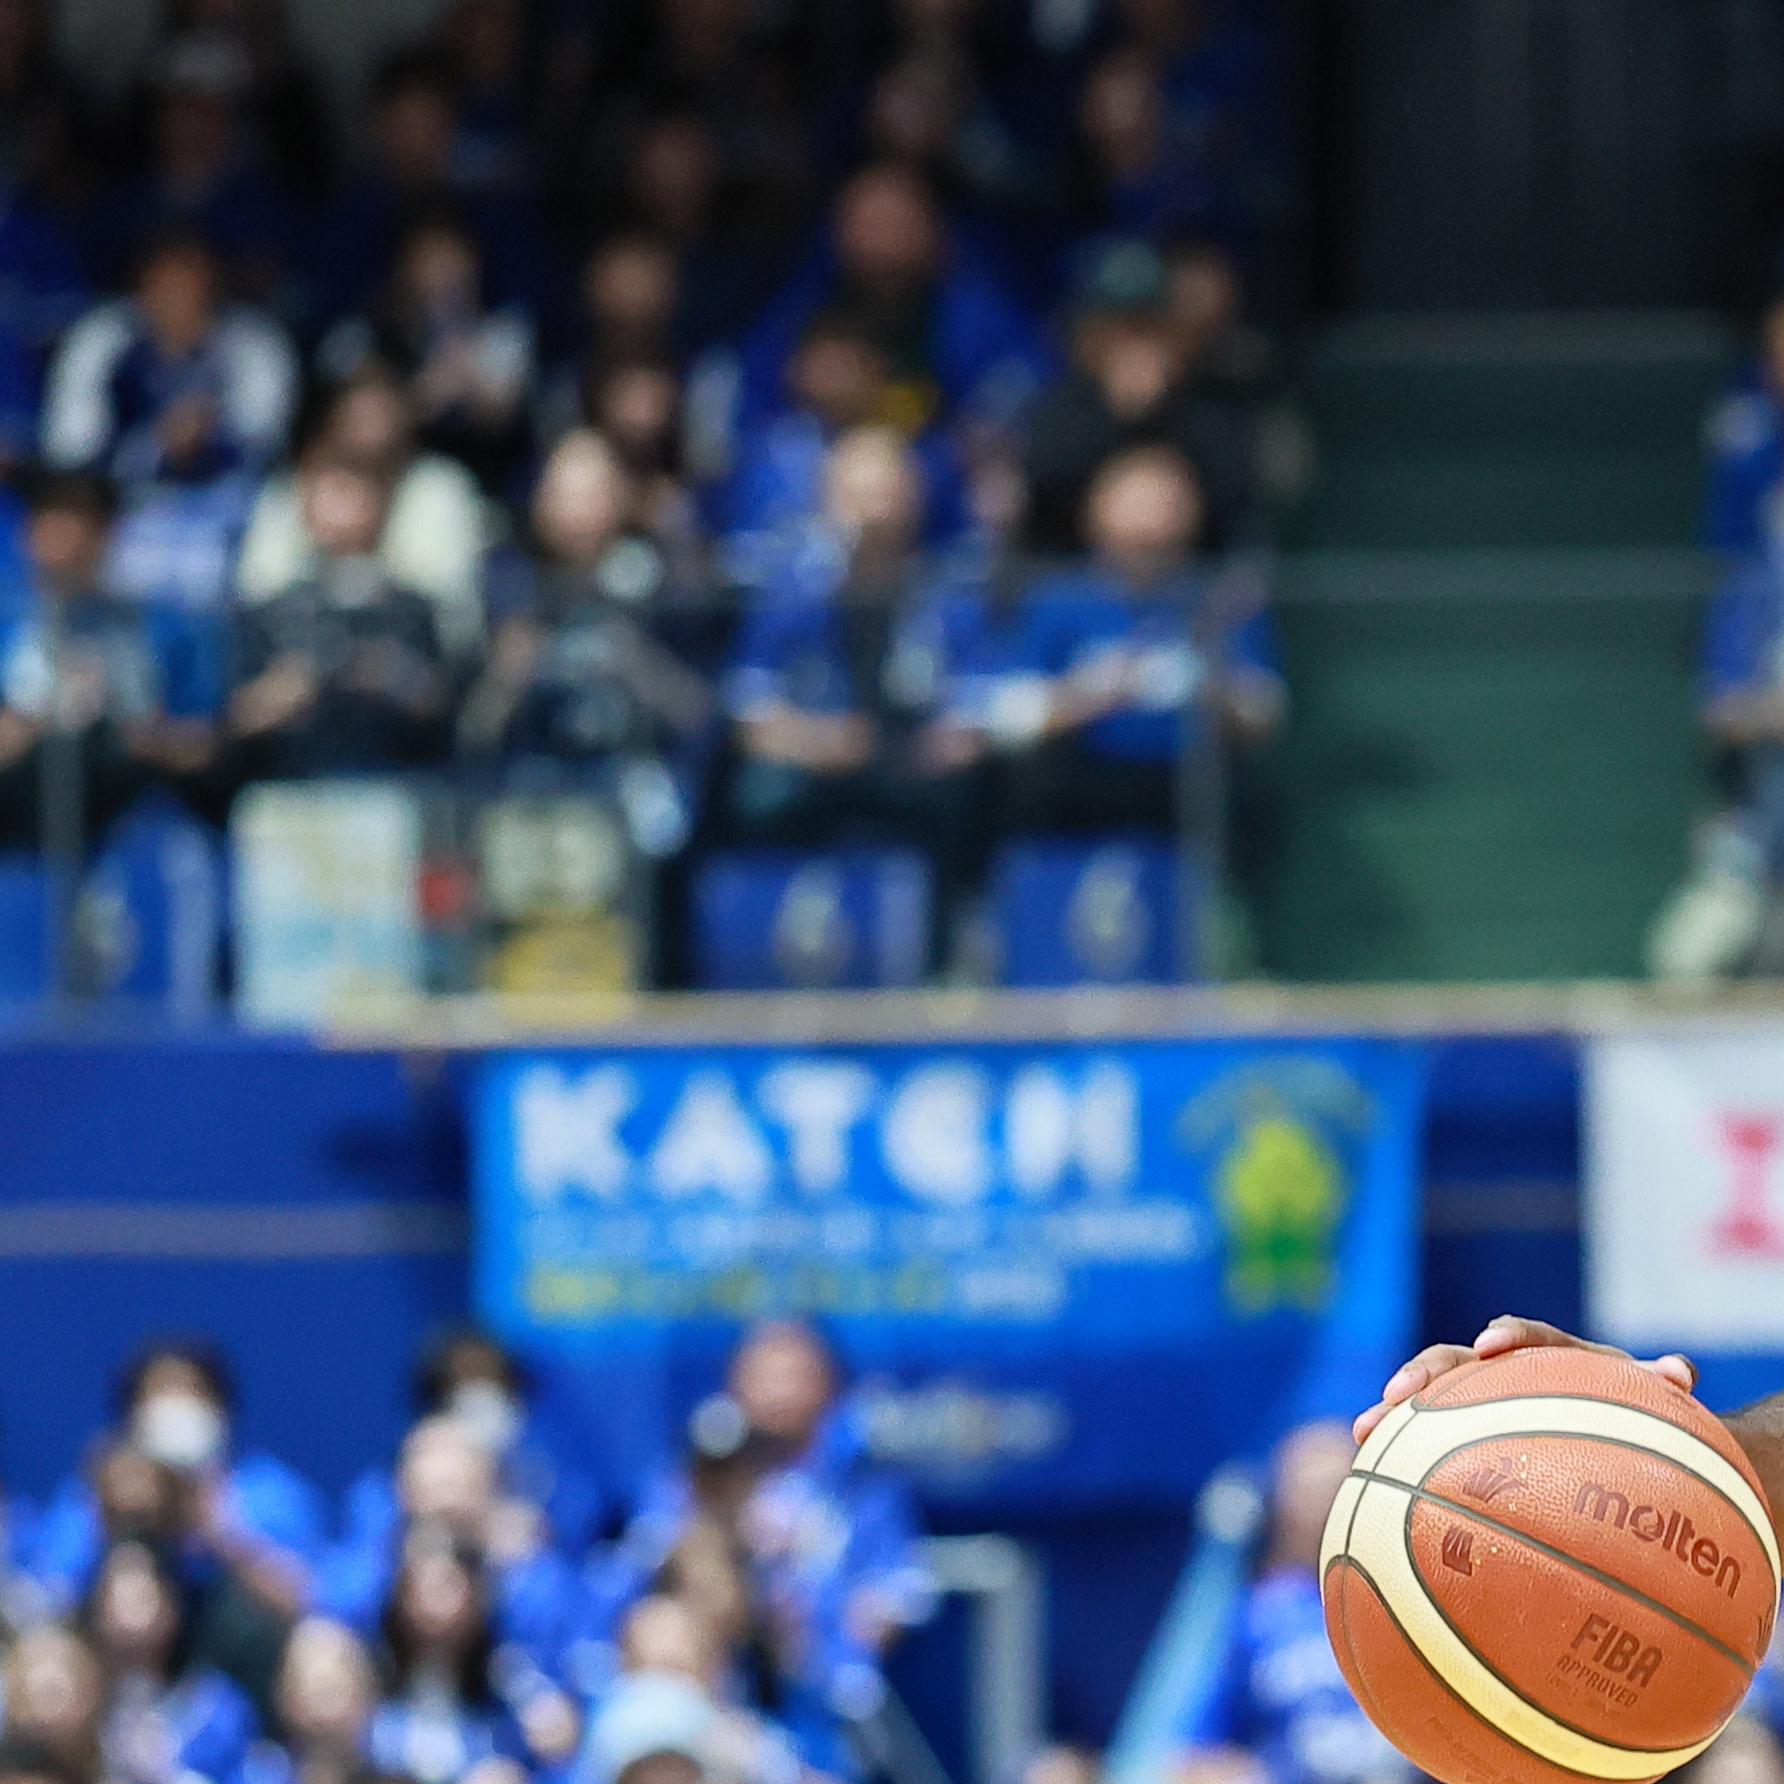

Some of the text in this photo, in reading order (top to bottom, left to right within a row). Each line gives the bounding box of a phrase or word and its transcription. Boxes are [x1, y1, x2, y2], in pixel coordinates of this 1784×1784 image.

[1574, 1482, 1742, 1599] molten
[1556, 1655, 1639, 1708] APPROVED
[1570, 1613, 1664, 1689] FIBA
